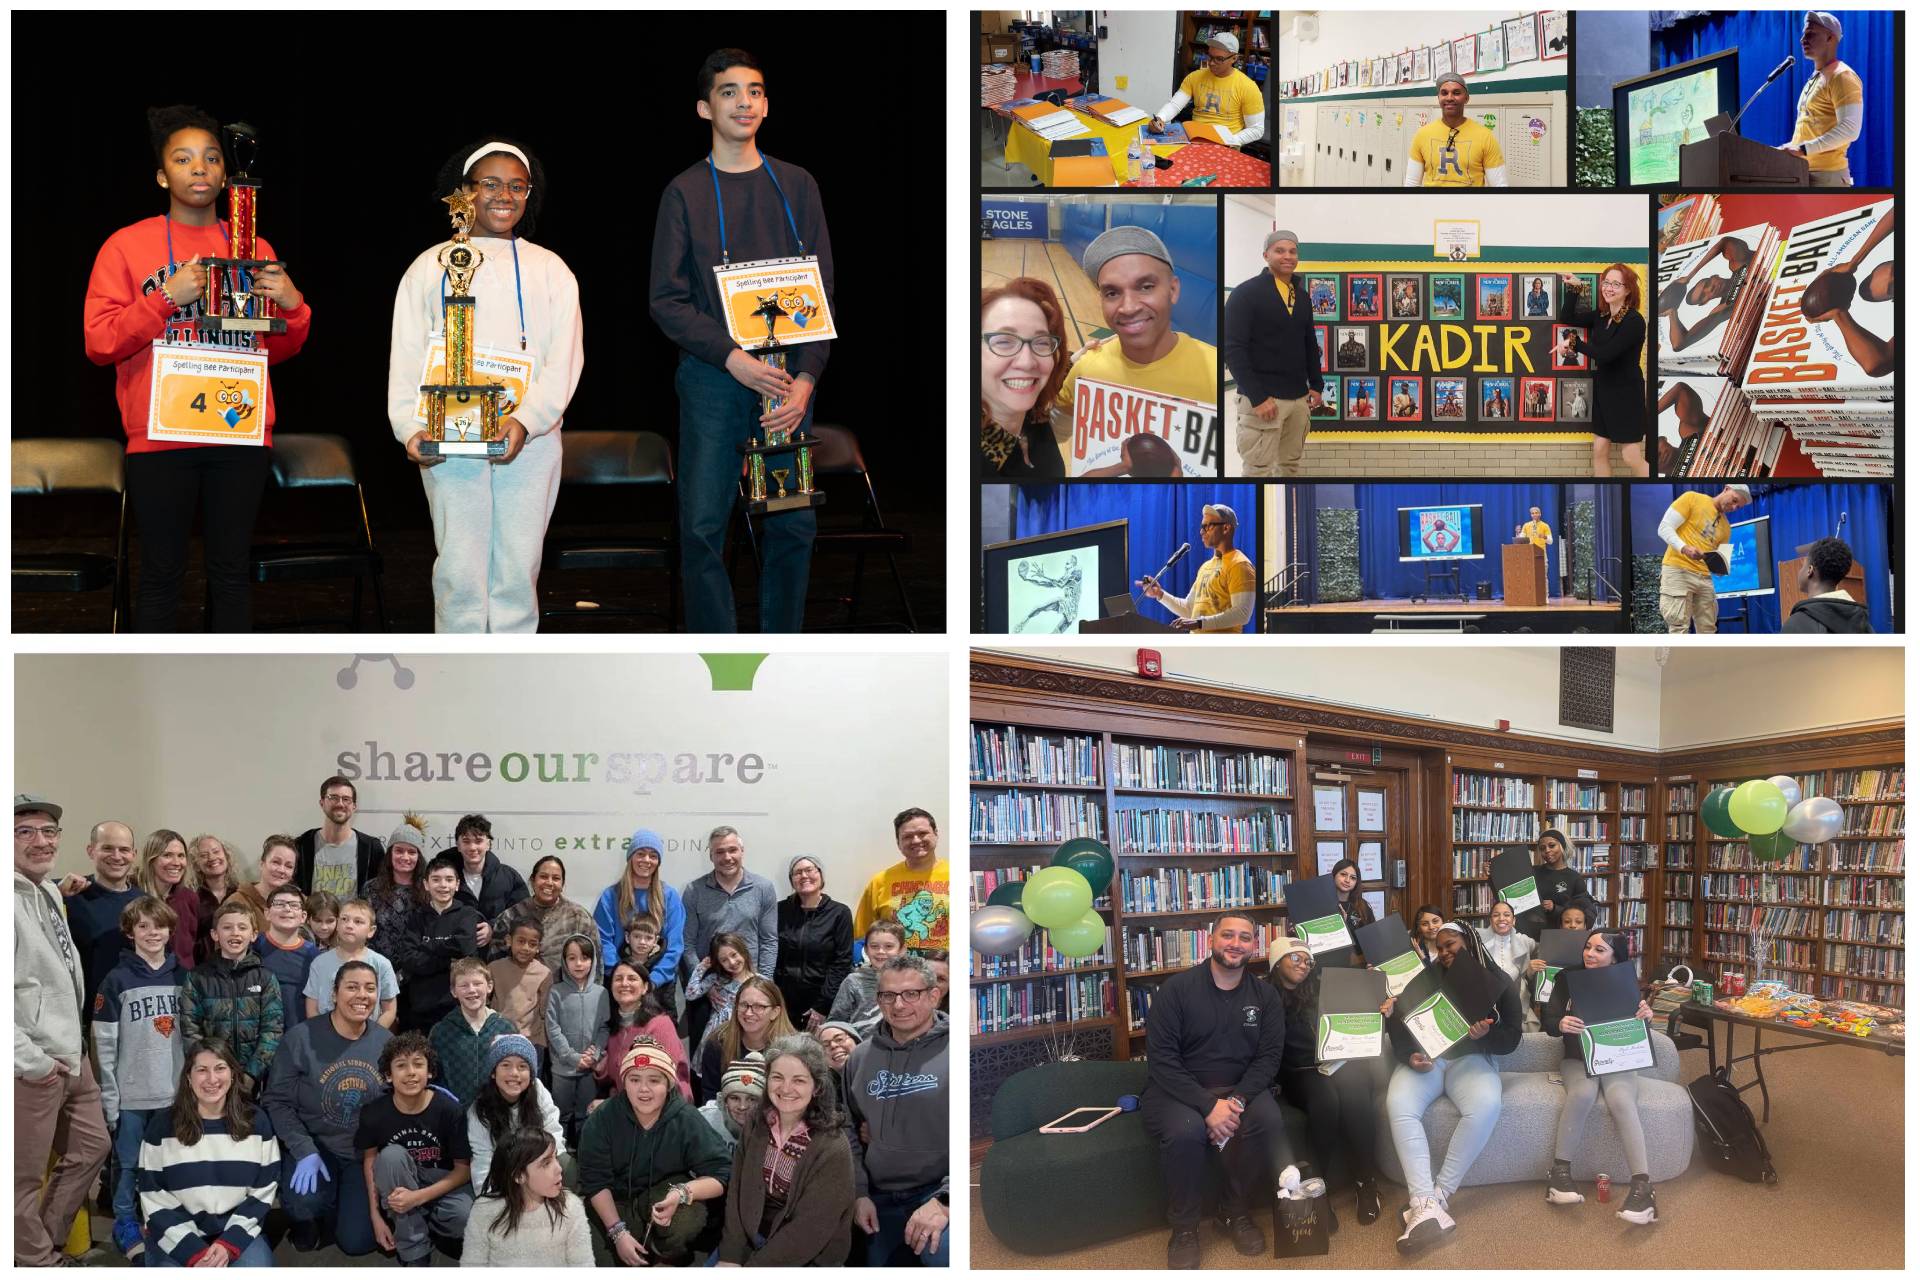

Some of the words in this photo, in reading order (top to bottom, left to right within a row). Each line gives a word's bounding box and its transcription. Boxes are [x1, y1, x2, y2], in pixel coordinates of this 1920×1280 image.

[1438, 146, 1463, 176] R
[986, 209, 1030, 220] STONE
[988, 220, 1033, 231] AGLES
[1780, 208, 1874, 279] BALL
[1828, 230, 1861, 267] ALL-AMERICAN
[1860, 217, 1877, 232] GAME
[736, 277, 762, 289] Spelling
[763, 276, 775, 284] Bee
[775, 273, 808, 284] Participant
[1747, 283, 1838, 384] BASKET
[1380, 323, 1535, 374] KADIR
[173, 360, 202, 374] Spelling
[203, 363, 217, 371] Bee
[218, 364, 255, 376] Participant
[486, 359, 522, 374] Participant
[190, 392, 207, 413] 4
[1074, 384, 1178, 460] BASKET
[1351, 752, 1366, 761] EXIT
[496, 838, 544, 851] INTO
[337, 1076, 369, 1092] FESTIVAL
